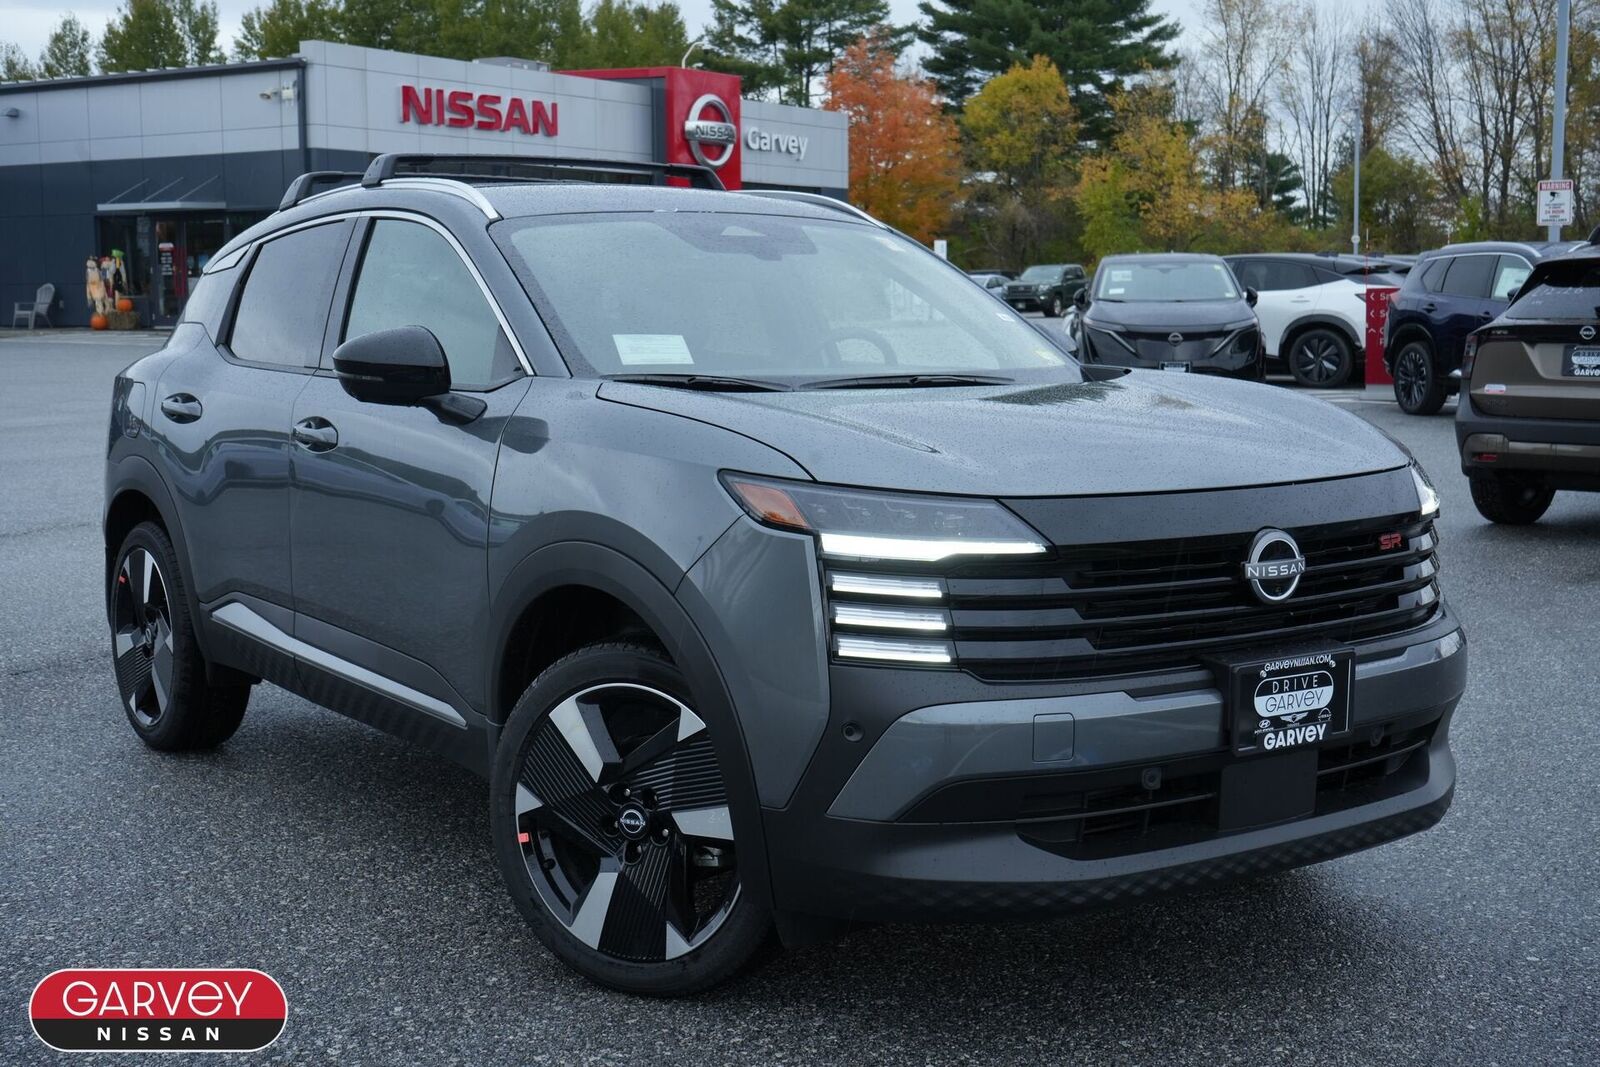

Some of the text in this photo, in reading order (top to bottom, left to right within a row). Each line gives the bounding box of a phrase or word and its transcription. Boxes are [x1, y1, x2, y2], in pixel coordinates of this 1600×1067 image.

[401, 85, 558, 137] NISSAN
[747, 126, 808, 161] Garvey
[1541, 182, 1570, 190] WARNING
[1379, 532, 1403, 550] SR
[1247, 560, 1306, 577] NISSAN
[1272, 675, 1319, 693] DRIVE
